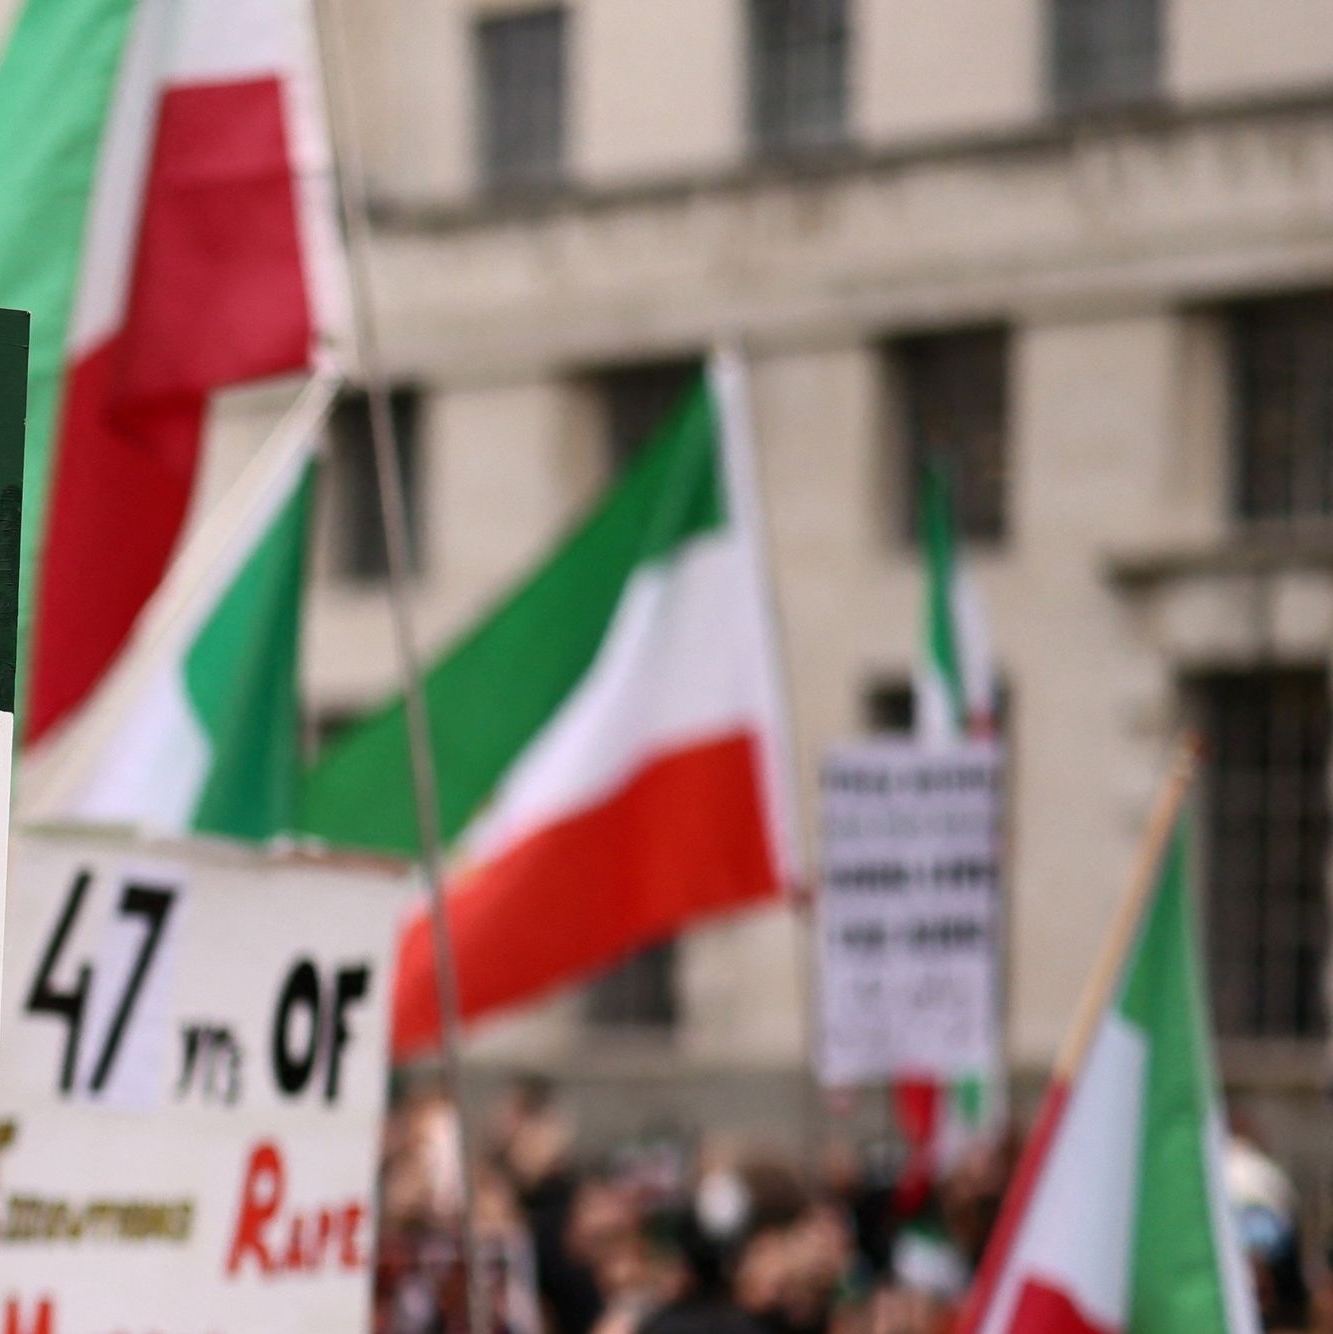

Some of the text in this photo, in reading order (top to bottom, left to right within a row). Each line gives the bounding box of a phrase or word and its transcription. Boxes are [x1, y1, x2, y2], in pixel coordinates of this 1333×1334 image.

[23, 866, 180, 1094] 47
[272, 956, 372, 1105] OF
[227, 1138, 366, 1278] RAPE
